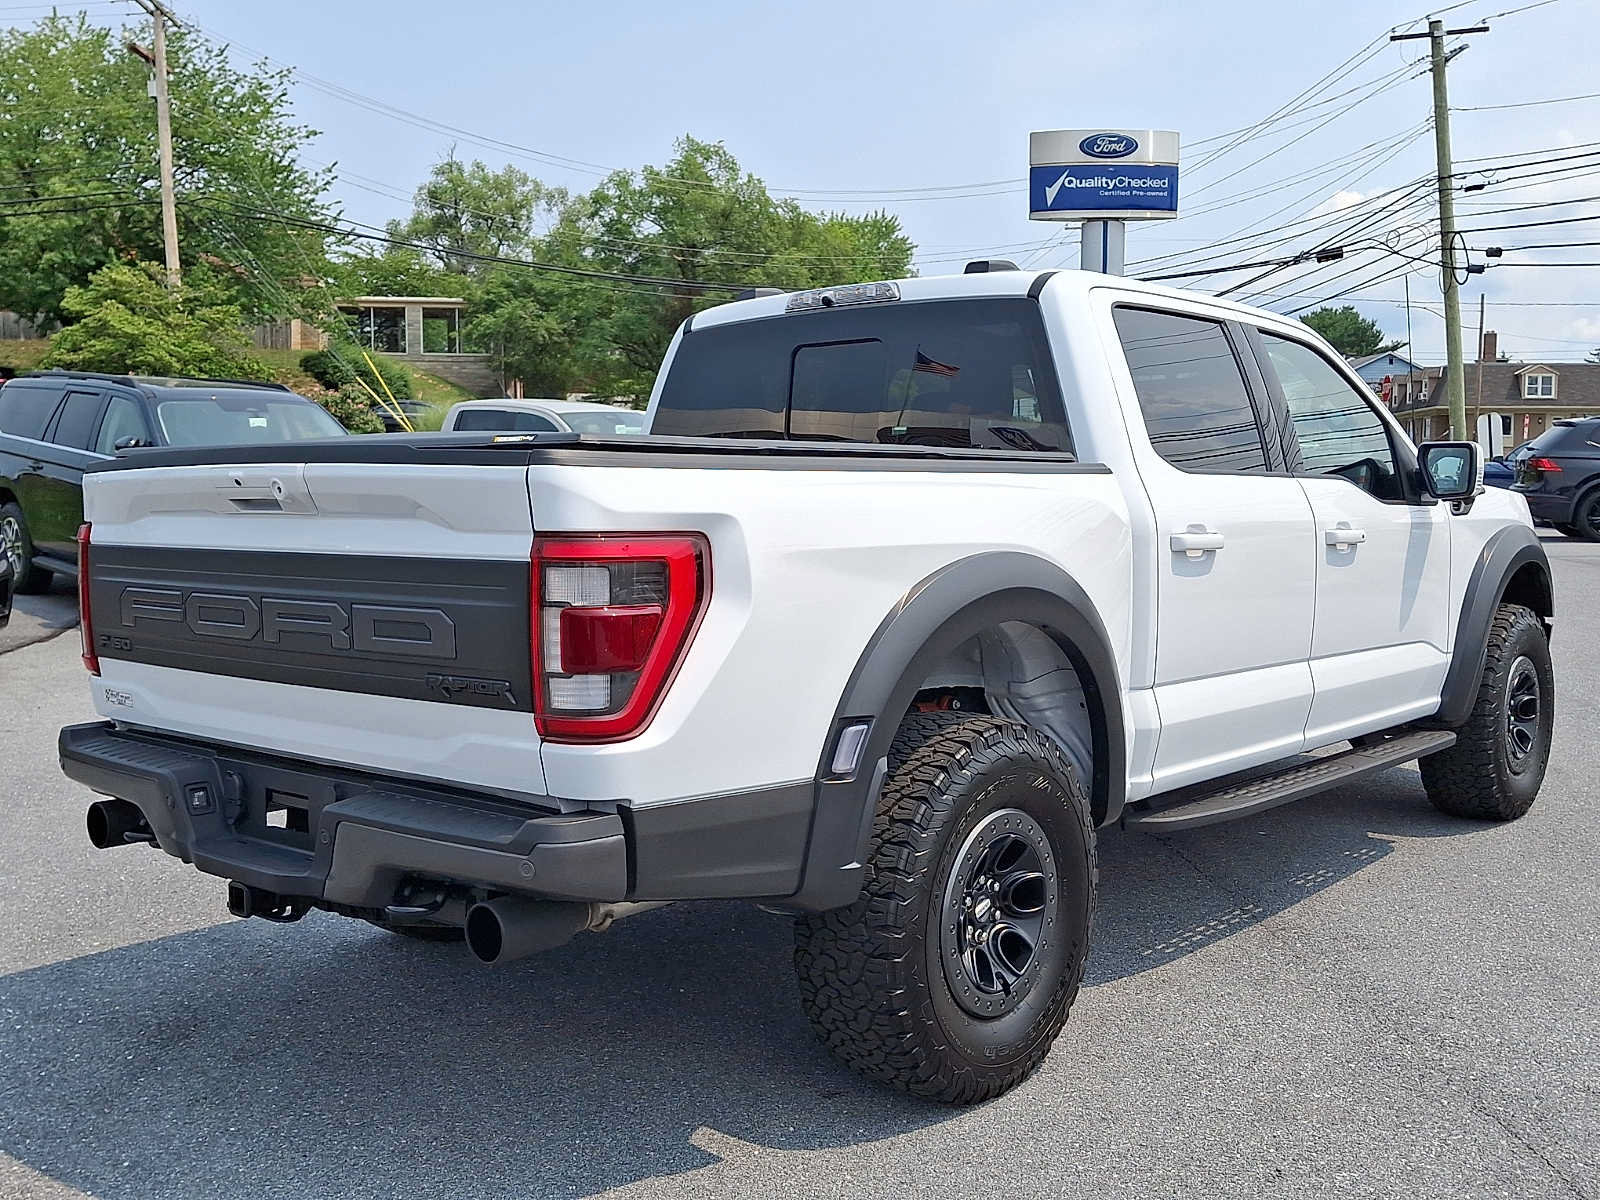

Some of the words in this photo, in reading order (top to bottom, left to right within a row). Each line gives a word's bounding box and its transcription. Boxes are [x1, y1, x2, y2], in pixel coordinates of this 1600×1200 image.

[1093, 136, 1127, 153] Ford
[1063, 176, 1169, 190] QualityChecked
[120, 587, 457, 660] FORD
[424, 673, 517, 704] RAPTOR
